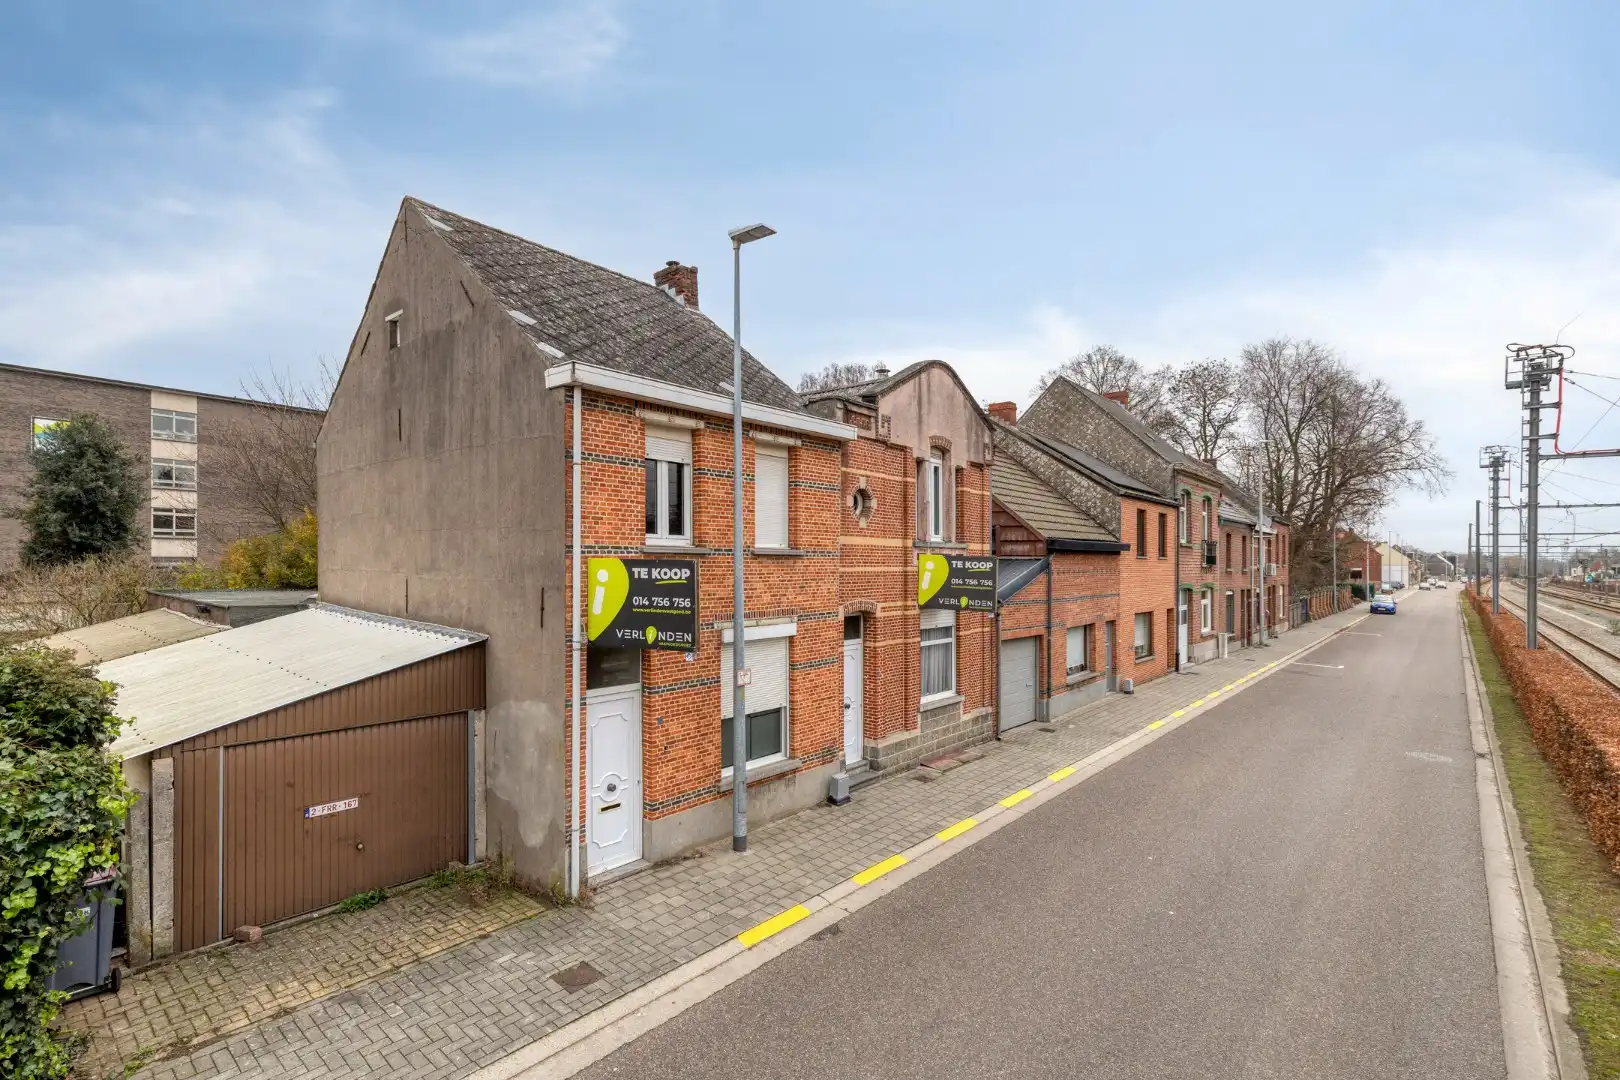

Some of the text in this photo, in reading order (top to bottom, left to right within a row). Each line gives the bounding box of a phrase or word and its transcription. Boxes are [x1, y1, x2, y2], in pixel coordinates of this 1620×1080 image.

[951, 560, 993, 570] TE KOOP
[632, 567, 691, 580] TE KOOP
[632, 596, 691, 608] 014 756 756
